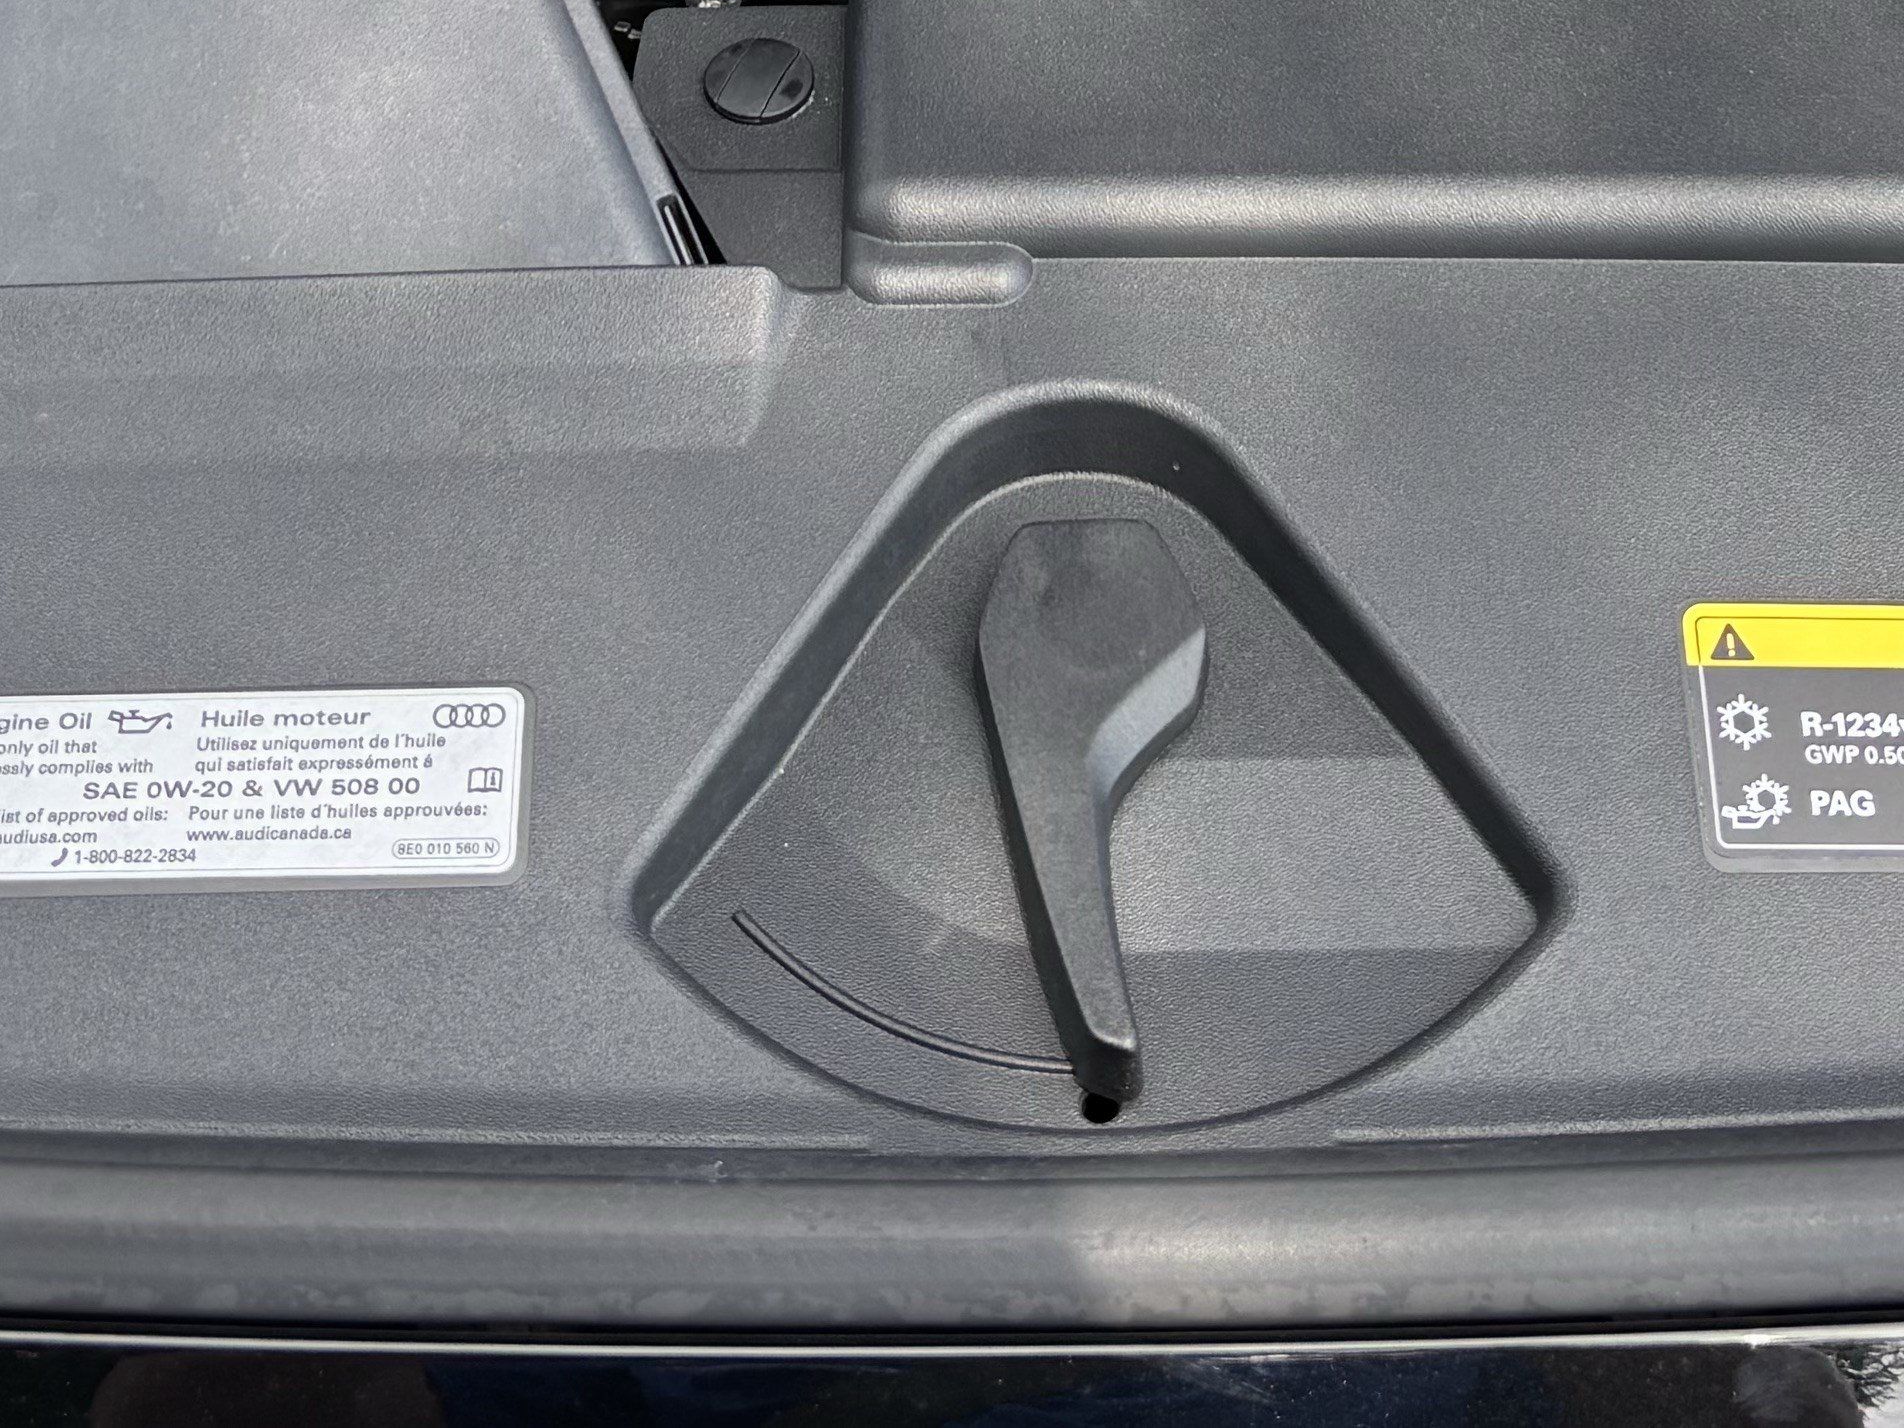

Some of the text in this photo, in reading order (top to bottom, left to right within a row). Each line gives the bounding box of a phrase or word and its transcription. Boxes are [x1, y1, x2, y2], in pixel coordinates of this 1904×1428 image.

[59, 712, 93, 730] Oil
[201, 710, 372, 728] Huile moteur
[38, 740, 58, 755] oil
[64, 740, 97, 754] that
[196, 735, 257, 751] Utilisez
[262, 735, 364, 753] uniquement
[369, 733, 390, 748] de
[1804, 744, 1860, 764] GWP
[38, 761, 113, 777] complies
[118, 759, 154, 774] with
[195, 756, 222, 775] qui
[226, 756, 293, 772] satisfait
[82, 776, 422, 801] SAE 0W-20 & VW 508 00
[188, 806, 228, 821] Pour
[233, 807, 265, 820] une
[270, 804, 306, 820] liste
[383, 803, 488, 820] approuvées:
[1810, 789, 1876, 817] PAG
[25, 808, 44, 823] of
[47, 807, 129, 826] approved
[133, 805, 168, 821] oils:
[186, 827, 352, 842] www.audicanada.ca
[74, 848, 196, 864] 1-800-822-2834
